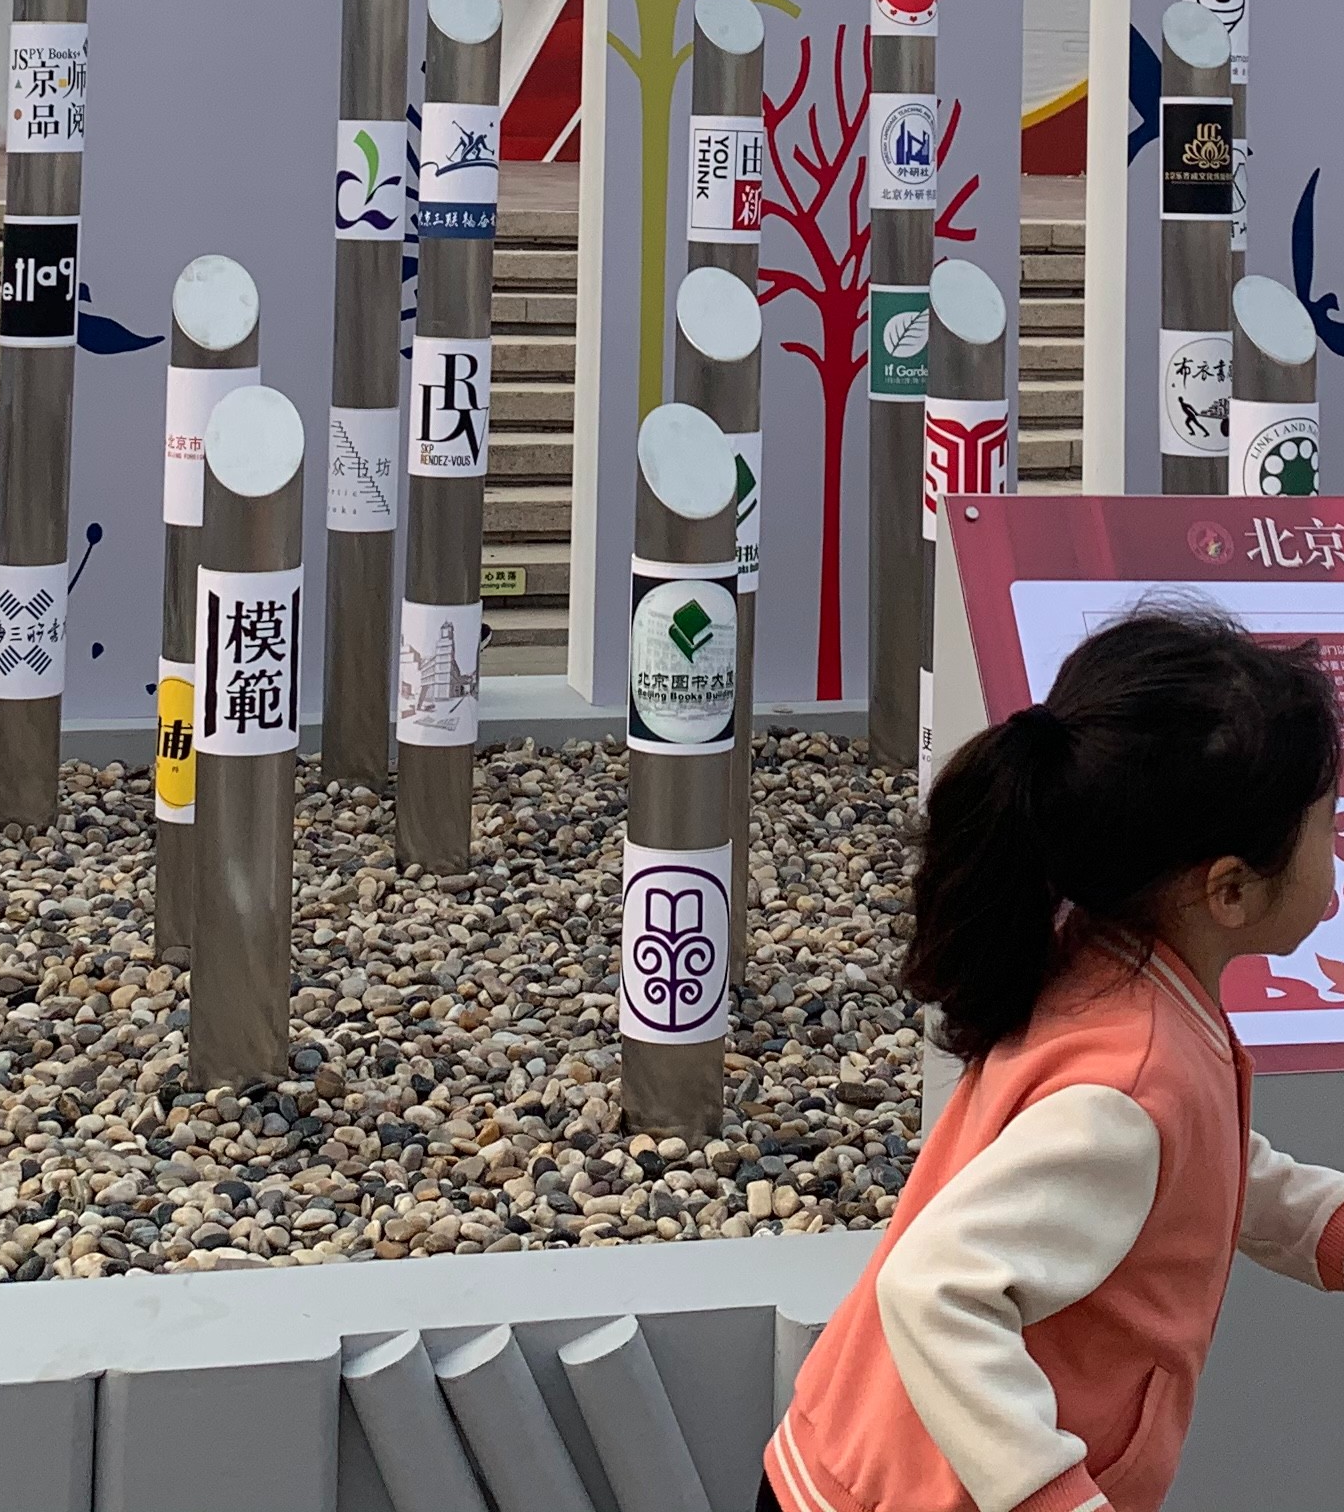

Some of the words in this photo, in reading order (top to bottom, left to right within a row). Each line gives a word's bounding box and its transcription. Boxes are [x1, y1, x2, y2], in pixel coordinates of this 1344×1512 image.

[696, 135, 712, 199] THINK
[713, 135, 730, 179] YOU
[896, 166, 929, 178] 外研社
[1249, 432, 1273, 460] LINK
[328, 456, 392, 479] 众书坊
[420, 452, 471, 467] RENDEZ-VOUS
[637, 688, 667, 702] Beijing
[670, 691, 703, 701] Books
